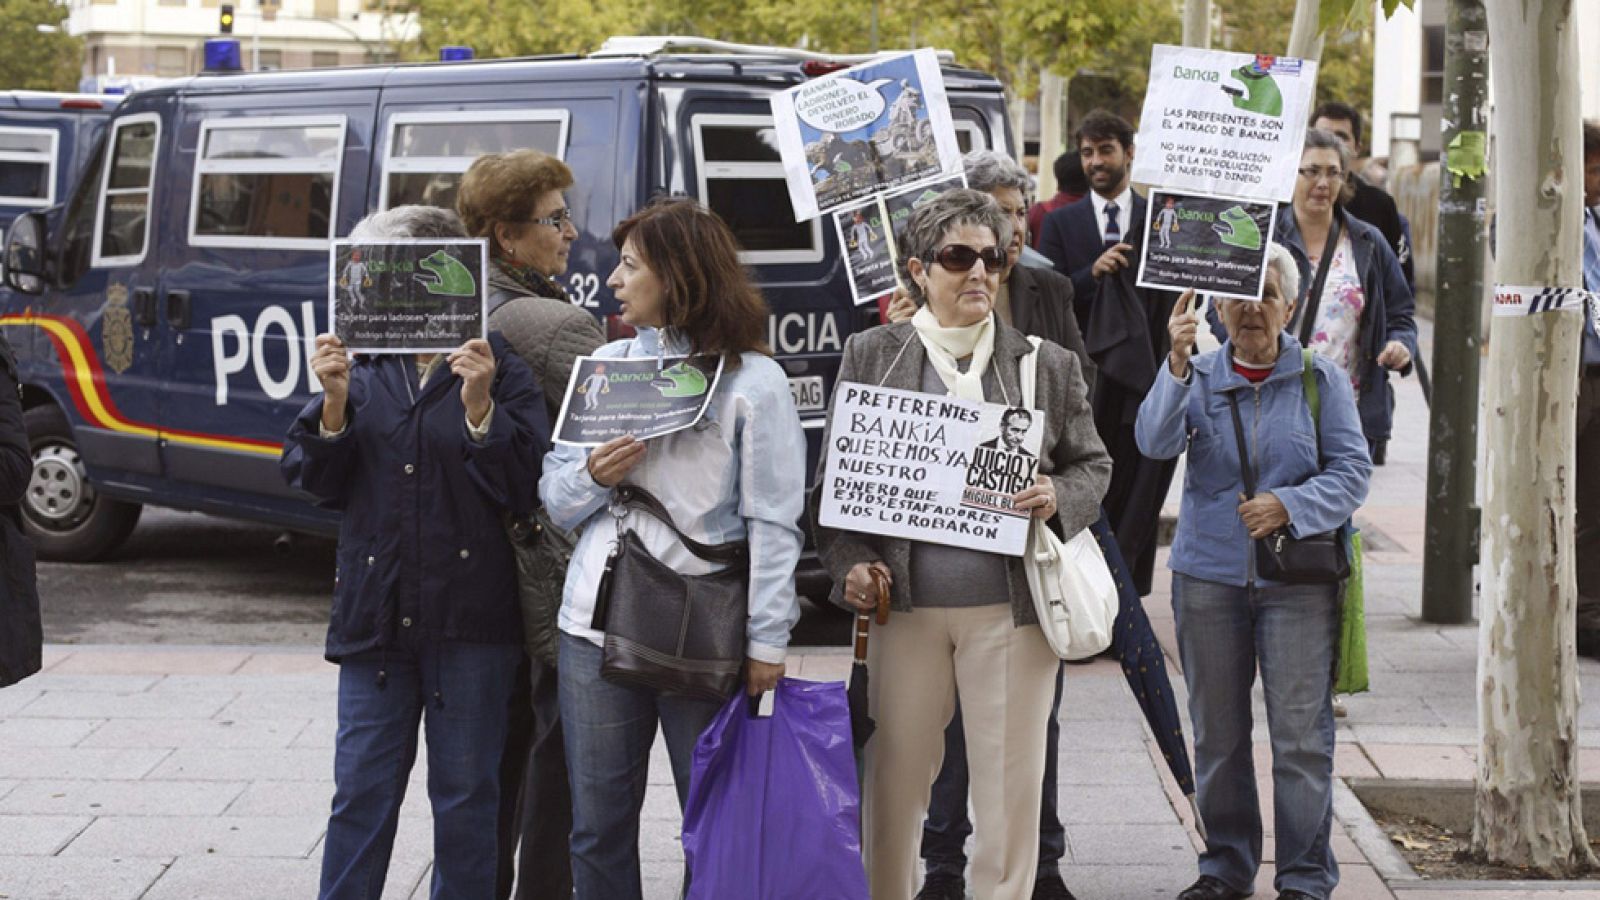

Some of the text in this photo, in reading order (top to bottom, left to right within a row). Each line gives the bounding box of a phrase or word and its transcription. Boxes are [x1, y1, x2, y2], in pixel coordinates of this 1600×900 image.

[1173, 66, 1220, 82] Bankia
[803, 79, 838, 97] BANKIA
[798, 87, 848, 111] LADRONES
[808, 91, 868, 117] DEVOLVED EL
[823, 106, 859, 124] DINERO
[835, 111, 876, 129] ROBADO
[1164, 108, 1284, 130] LAS PREFERENTES SON
[1162, 119, 1280, 142] EL ATRACO DE BANKIA
[1160, 142, 1272, 163] NO HAY MÁS SOLUCIÓN
[1166, 153, 1263, 173] QUE LA DEVOLUCIÓN
[1164, 164, 1261, 184] DE NUESTRO DINERO
[1177, 207, 1215, 222] Bankia
[563, 272, 600, 307] 32
[368, 314, 387, 323] para
[769, 312, 841, 353] ICIA
[211, 301, 324, 405] POL
[609, 373, 654, 382] Bankia
[845, 388, 980, 423] PREFERENTES
[839, 458, 927, 482] NUESTRO
[967, 446, 1039, 479] JUICIO Y
[904, 488, 939, 501] QUE
[963, 489, 997, 507] MIGUEL
[840, 504, 998, 540] NOS LO ROBARON
